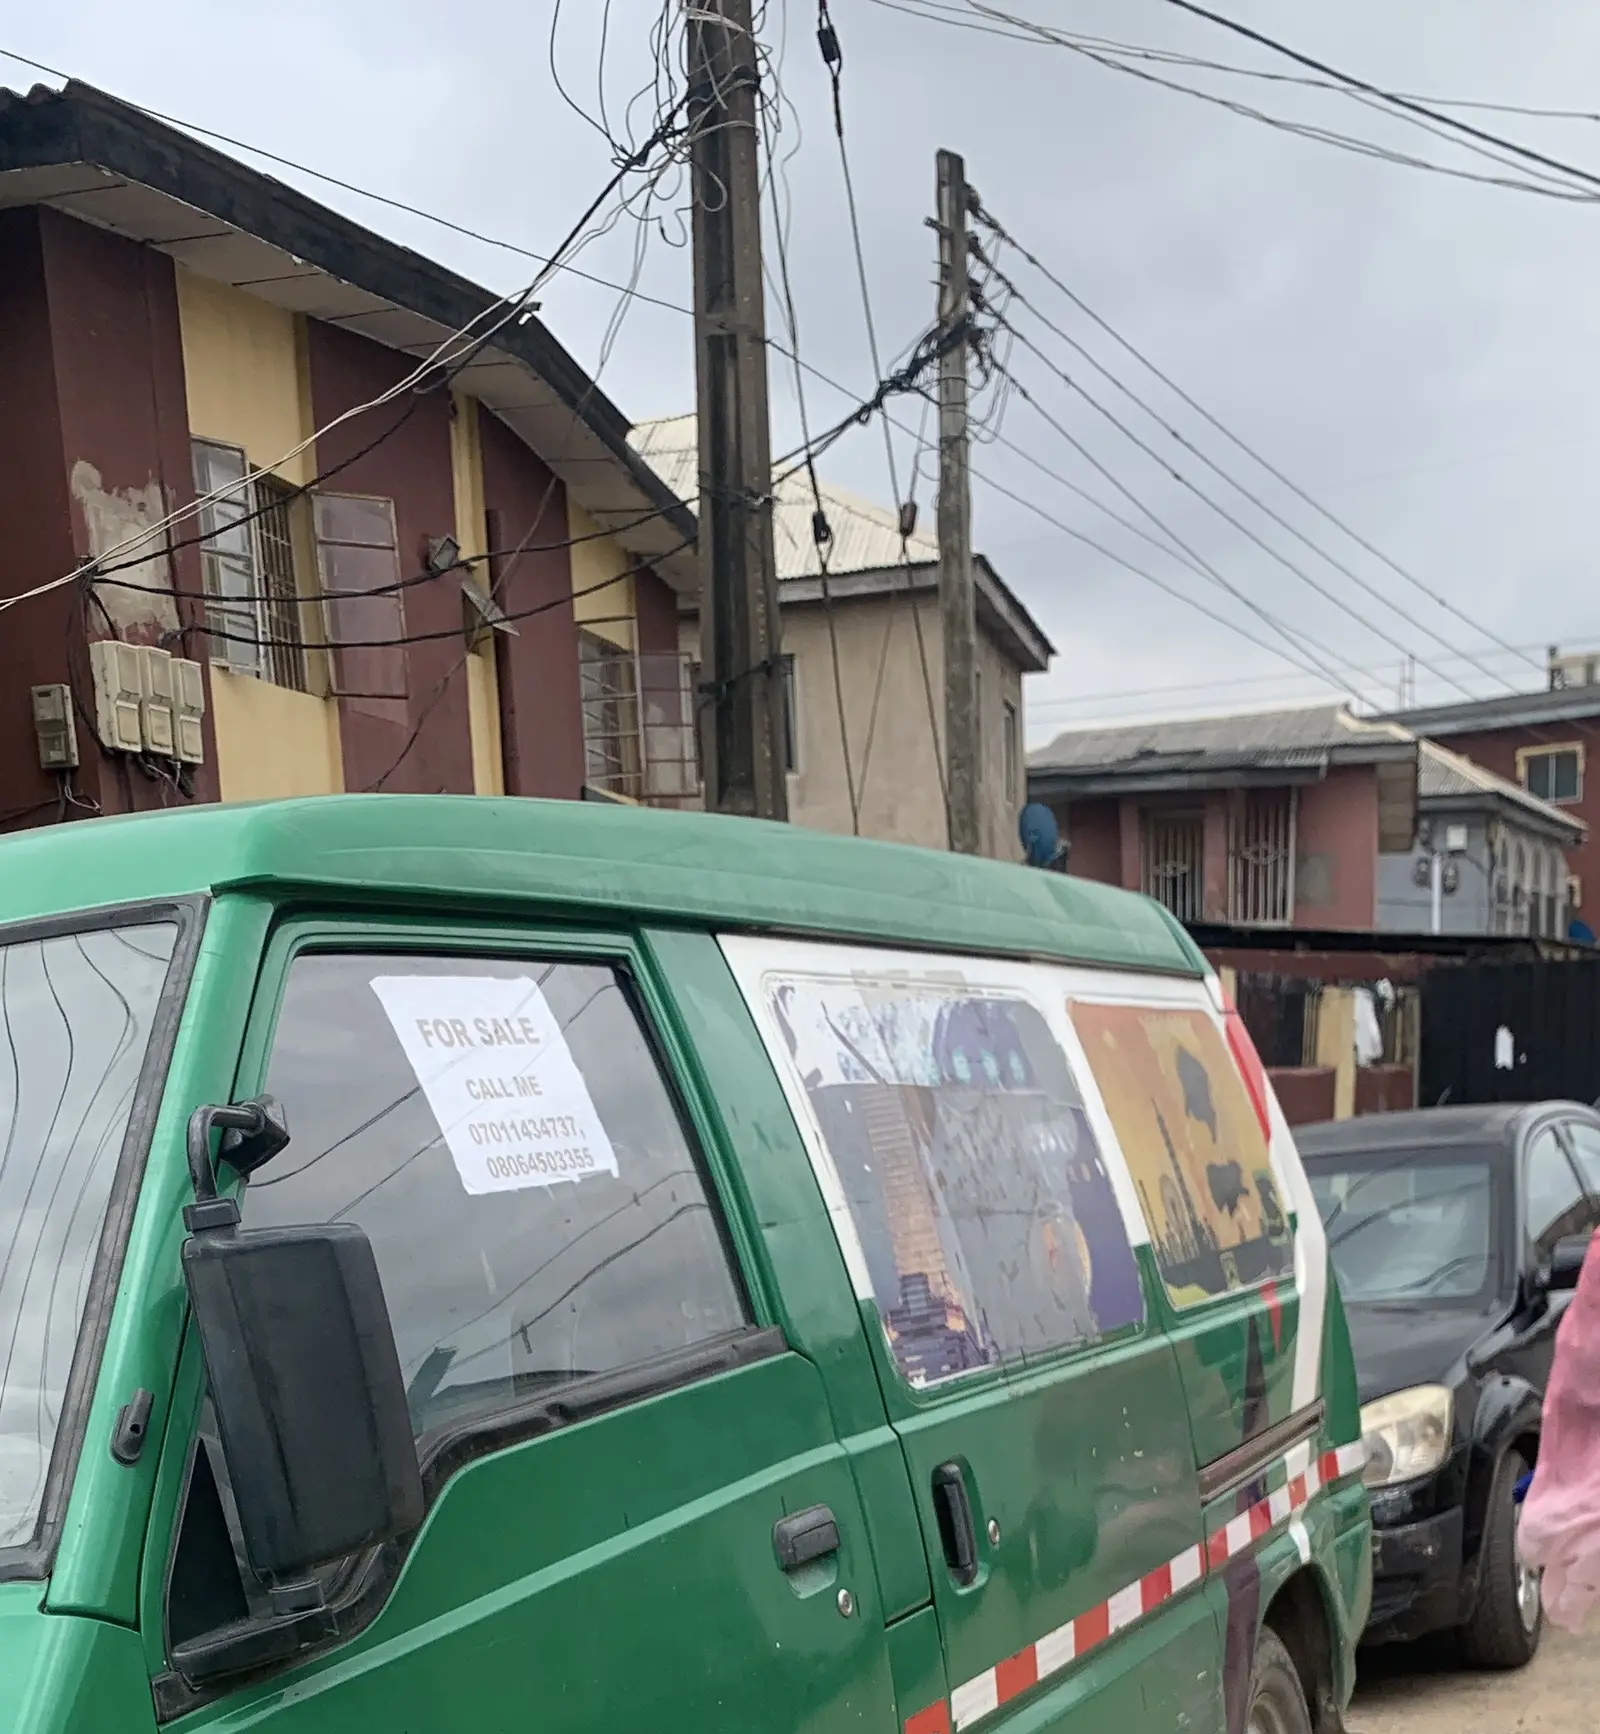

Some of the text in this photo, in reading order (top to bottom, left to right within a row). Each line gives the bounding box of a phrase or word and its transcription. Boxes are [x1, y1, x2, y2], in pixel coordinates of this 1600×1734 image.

[416, 1018, 541, 1048] FOR SALE
[466, 1076, 543, 1101] CALL ME
[468, 1115, 586, 1145] 07011434737,
[486, 1147, 595, 1178] 08064503355
